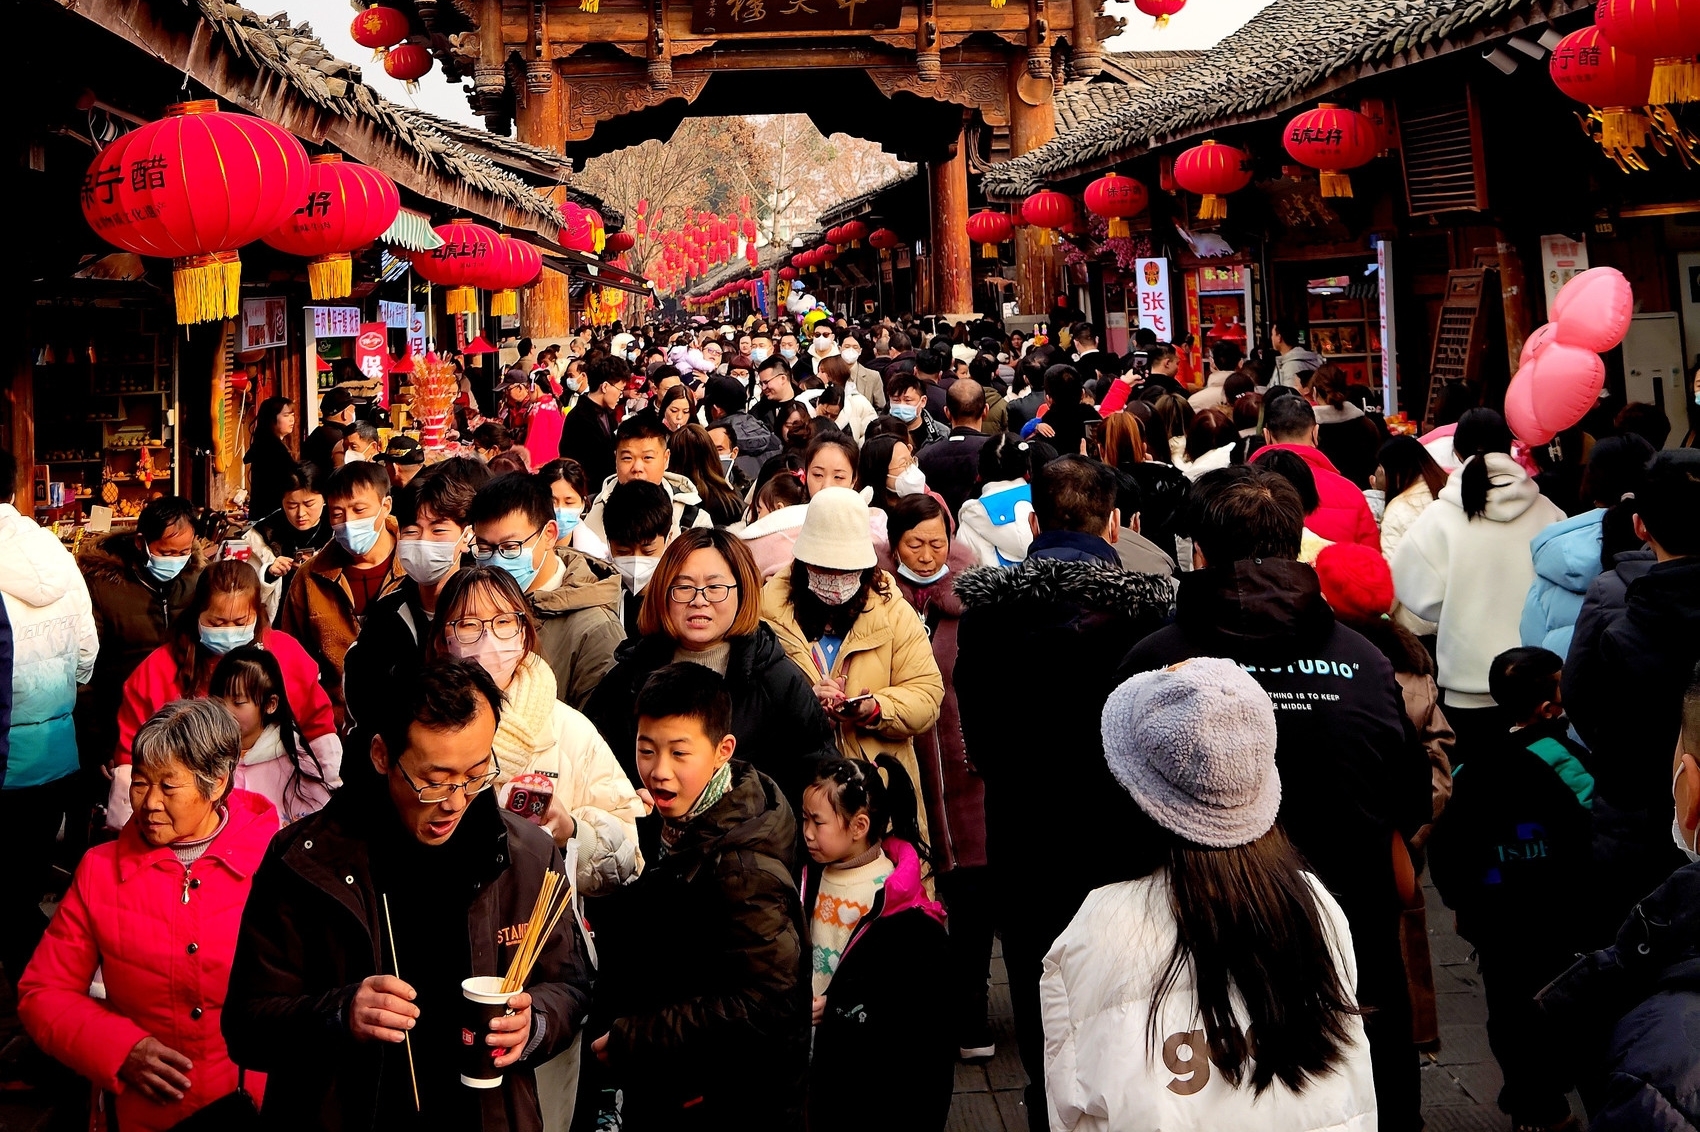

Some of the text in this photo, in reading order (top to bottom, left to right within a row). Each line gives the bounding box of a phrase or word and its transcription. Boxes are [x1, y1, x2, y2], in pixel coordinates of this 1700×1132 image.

[1291, 128, 1344, 145] 五虎上将
[293, 191, 333, 218] 将
[431, 242, 487, 262] 五虎上将
[1307, 692, 1319, 700] TO
[1321, 693, 1340, 701] KEEP
[1281, 702, 1312, 710] MIDDLE
